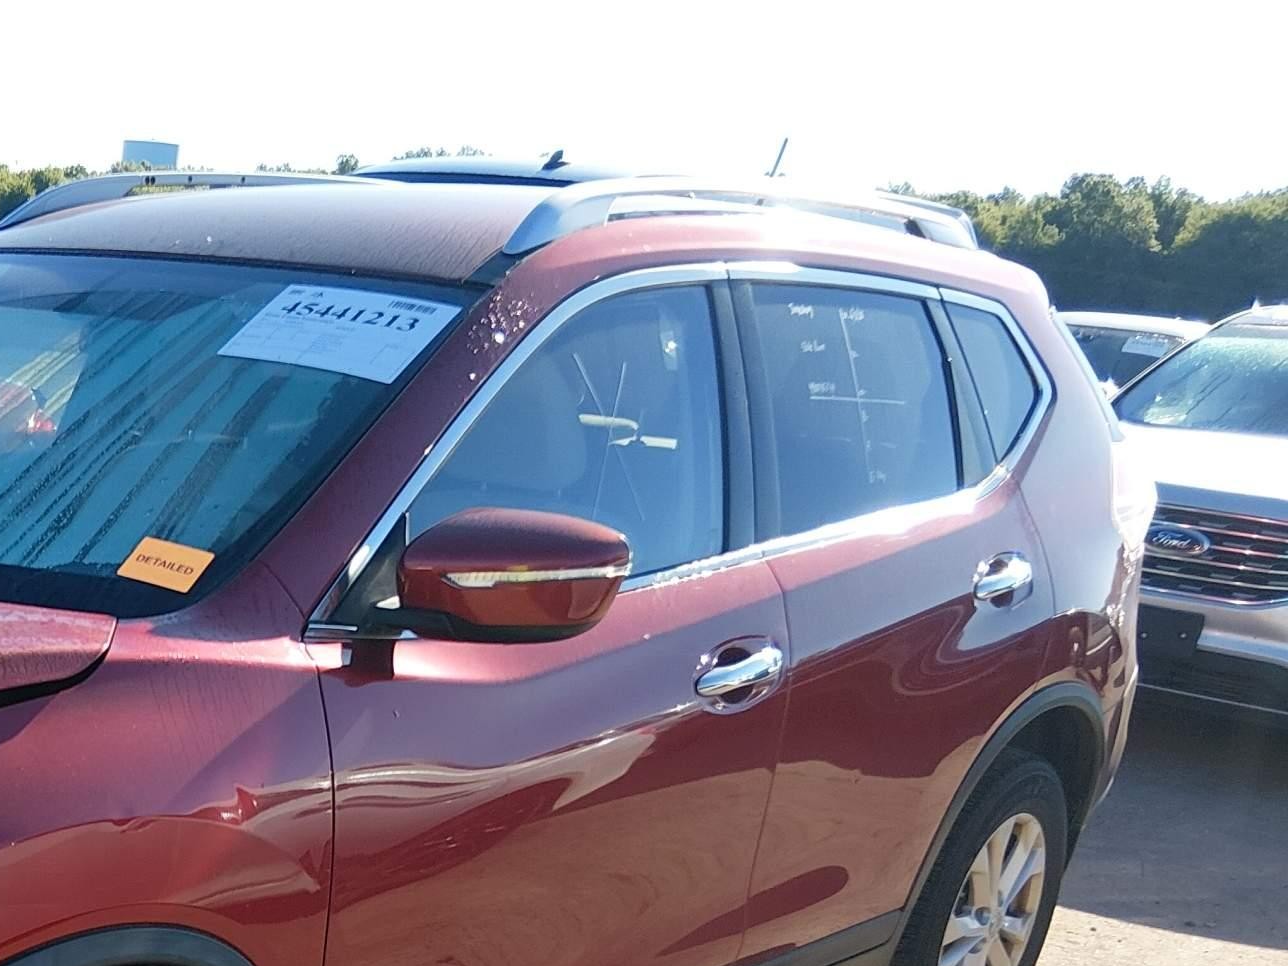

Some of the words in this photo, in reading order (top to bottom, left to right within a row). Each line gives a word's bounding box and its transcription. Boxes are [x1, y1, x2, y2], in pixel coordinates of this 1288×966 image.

[281, 300, 420, 332] 45441213
[1152, 530, 1192, 549] Ford
[136, 553, 194, 575] DETAILED
